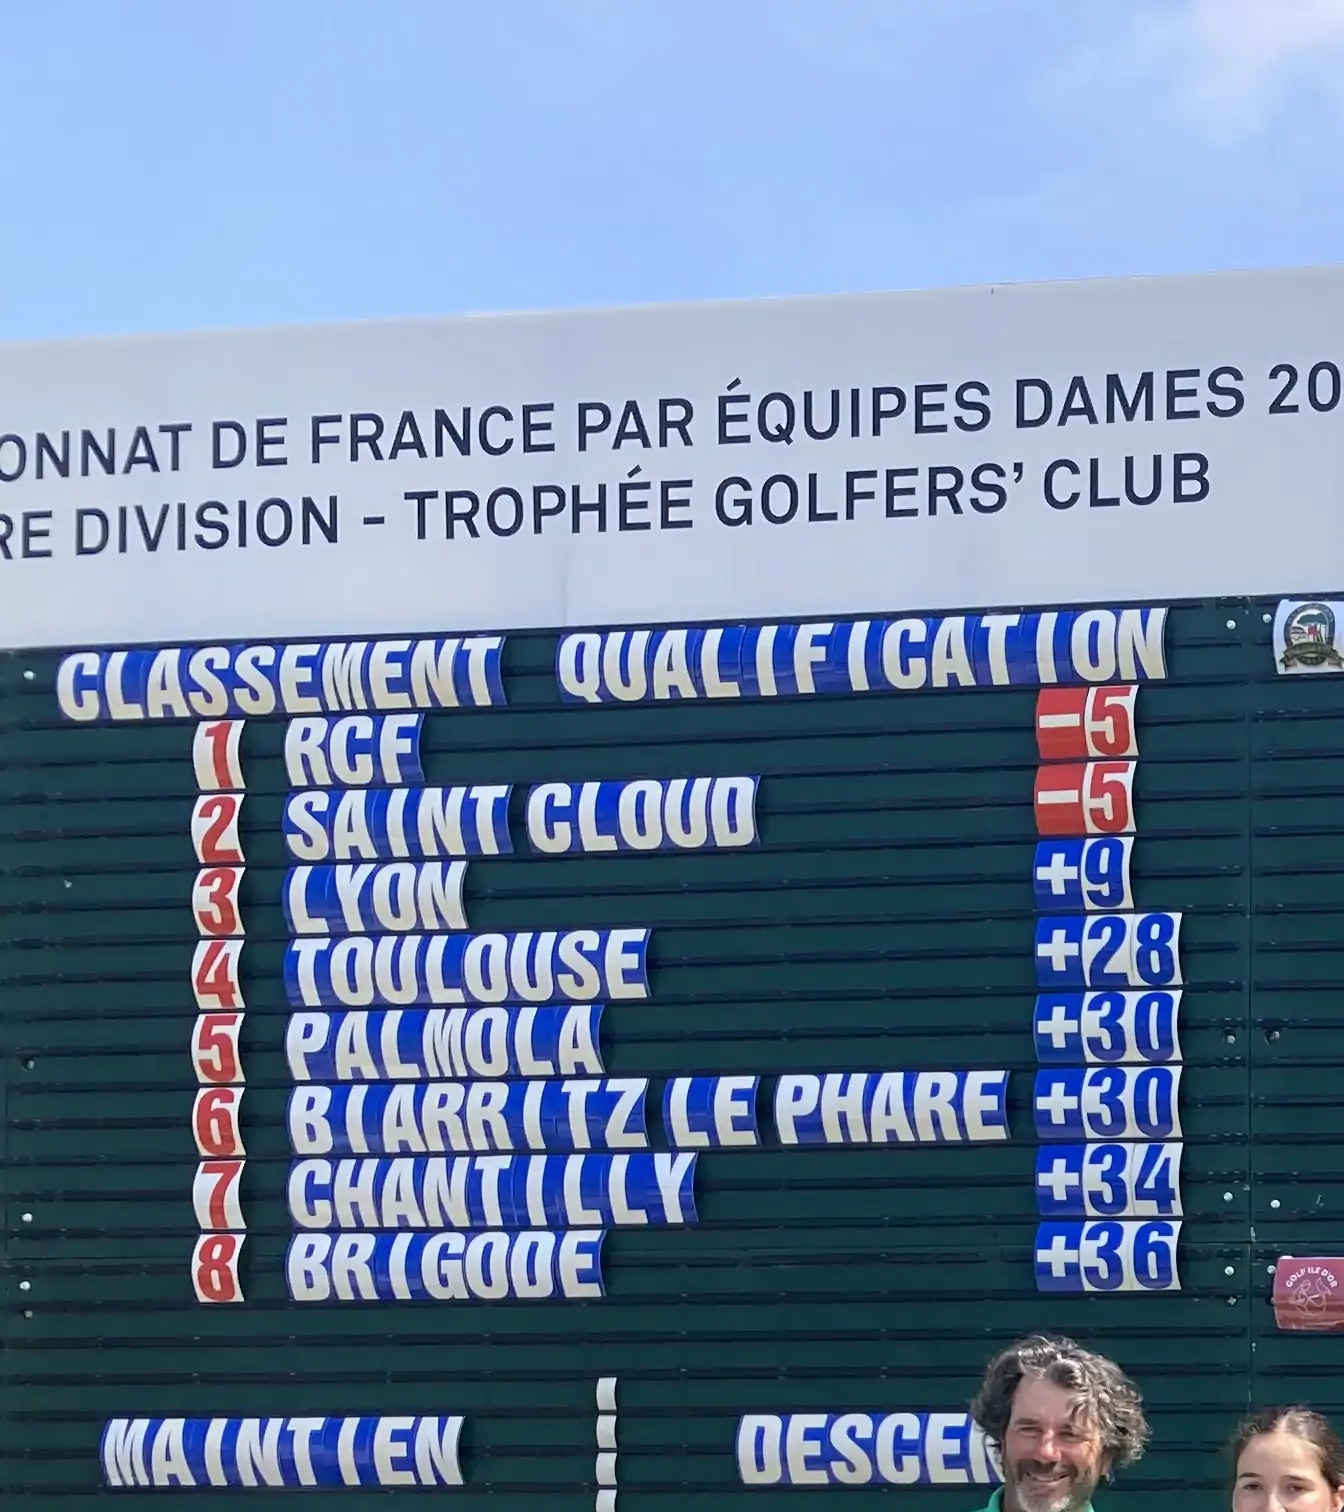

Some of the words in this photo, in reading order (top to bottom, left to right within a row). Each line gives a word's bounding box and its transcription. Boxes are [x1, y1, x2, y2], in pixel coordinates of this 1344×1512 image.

[0, 424, 192, 483] ONNAT
[211, 418, 288, 467] DE
[312, 403, 555, 464] FRANCE
[578, 397, 694, 452] PAR
[716, 378, 992, 446] ÉQUIPES
[1014, 366, 1246, 430] DAMES
[74, 494, 339, 557] DIVISION
[404, 465, 694, 540] TROPHÉE
[1043, 452, 1211, 511] CLUB
[57, 637, 501, 721] CLASSEMENT
[558, 607, 1167, 703] QUALIFICATION
[203, 721, 236, 788] 1
[284, 714, 420, 786] RCF
[1038, 686, 1132, 756] -5
[199, 797, 238, 861] 2
[286, 785, 510, 861] SAINT
[527, 776, 757, 853] CLOUD
[1037, 762, 1131, 833] -5
[199, 869, 237, 935] 3
[289, 861, 467, 933] LYON
[1037, 838, 1126, 908] +9
[197, 942, 236, 1009] 4
[290, 930, 650, 1006] TOULOUSE
[1037, 914, 1177, 986] +28
[198, 1014, 237, 1082] 5
[287, 1005, 602, 1080] PALMOLA
[1037, 991, 1176, 1061] +30
[199, 1089, 236, 1156] 6
[289, 1078, 648, 1154] BIARRITZ
[669, 1076, 757, 1146] LE
[775, 1071, 1008, 1144] PHARE
[1037, 1067, 1177, 1137] +30
[200, 1160, 240, 1227] 7
[289, 1152, 697, 1228] CHANTILLY
[1037, 1144, 1177, 1214] +34
[199, 1235, 237, 1300] 8
[288, 1230, 603, 1299] BRIGODE
[1037, 1221, 1176, 1290] +36
[103, 1417, 465, 1486] MAINTIEN
